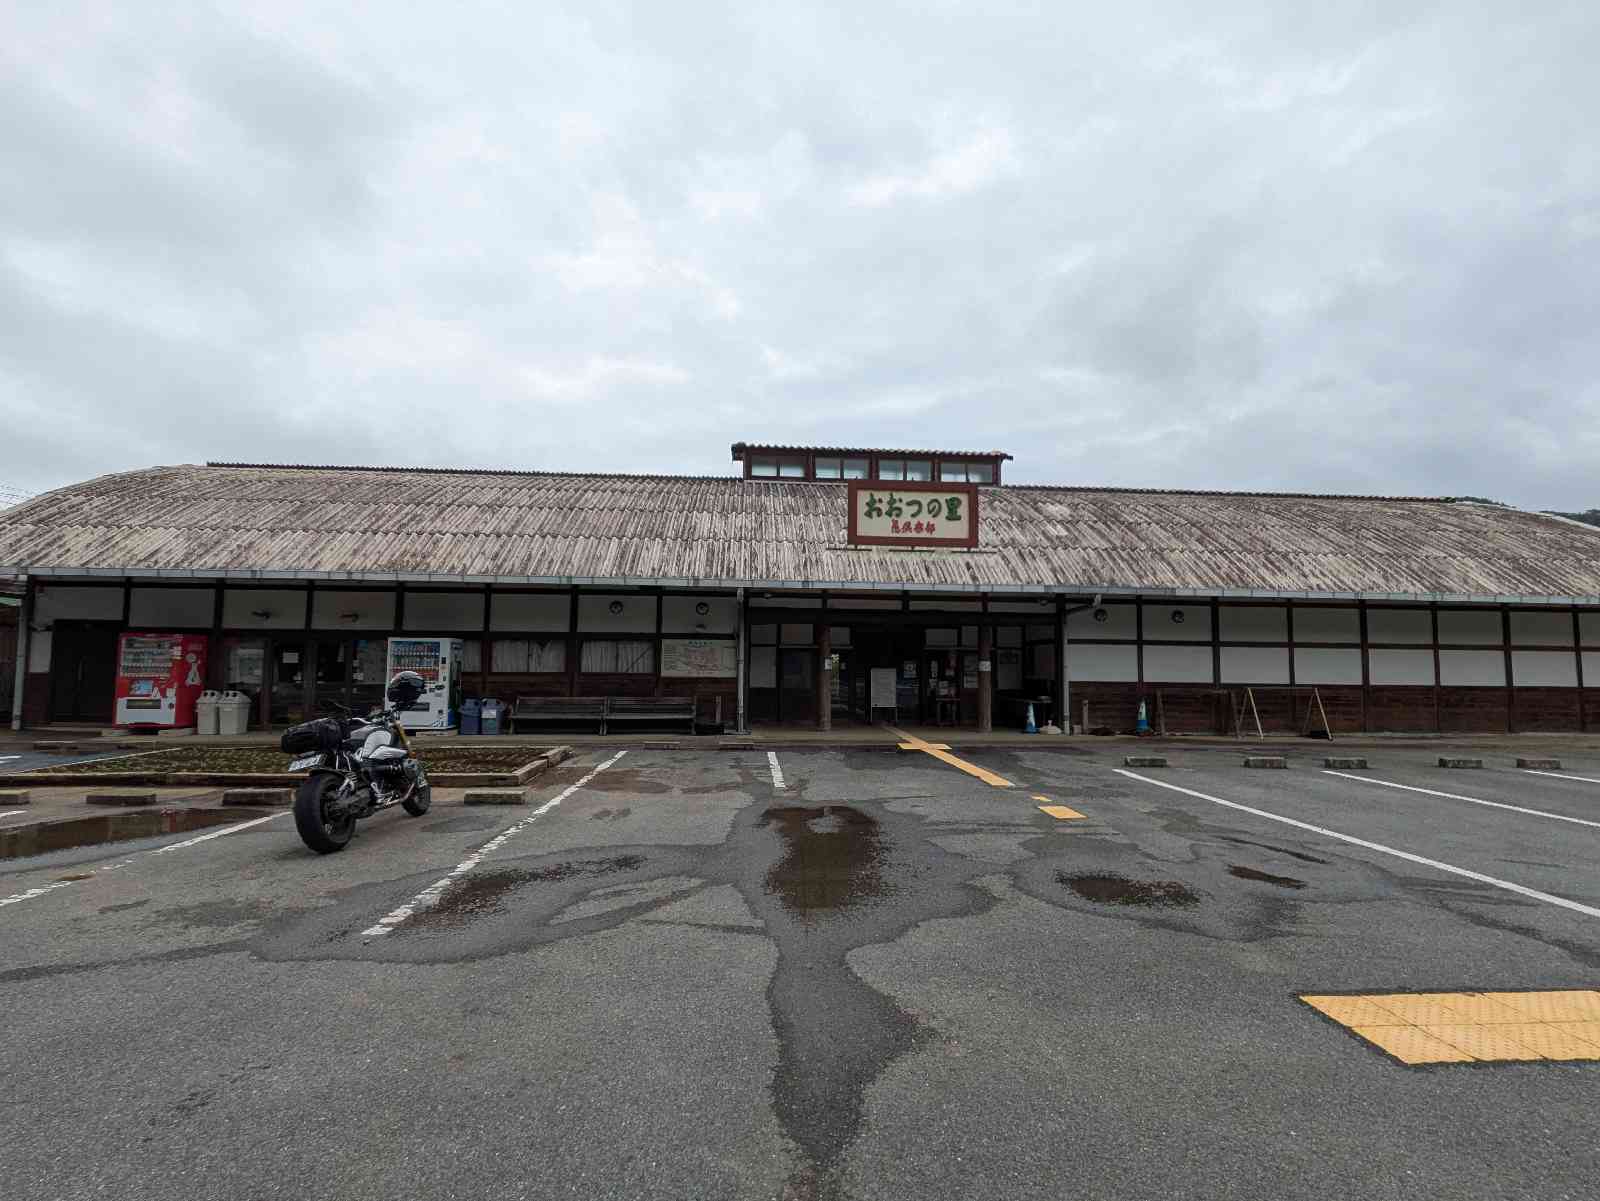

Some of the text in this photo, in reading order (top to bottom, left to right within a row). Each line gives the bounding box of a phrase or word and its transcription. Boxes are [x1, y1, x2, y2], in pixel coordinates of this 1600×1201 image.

[864, 492, 962, 521] おおつの里
